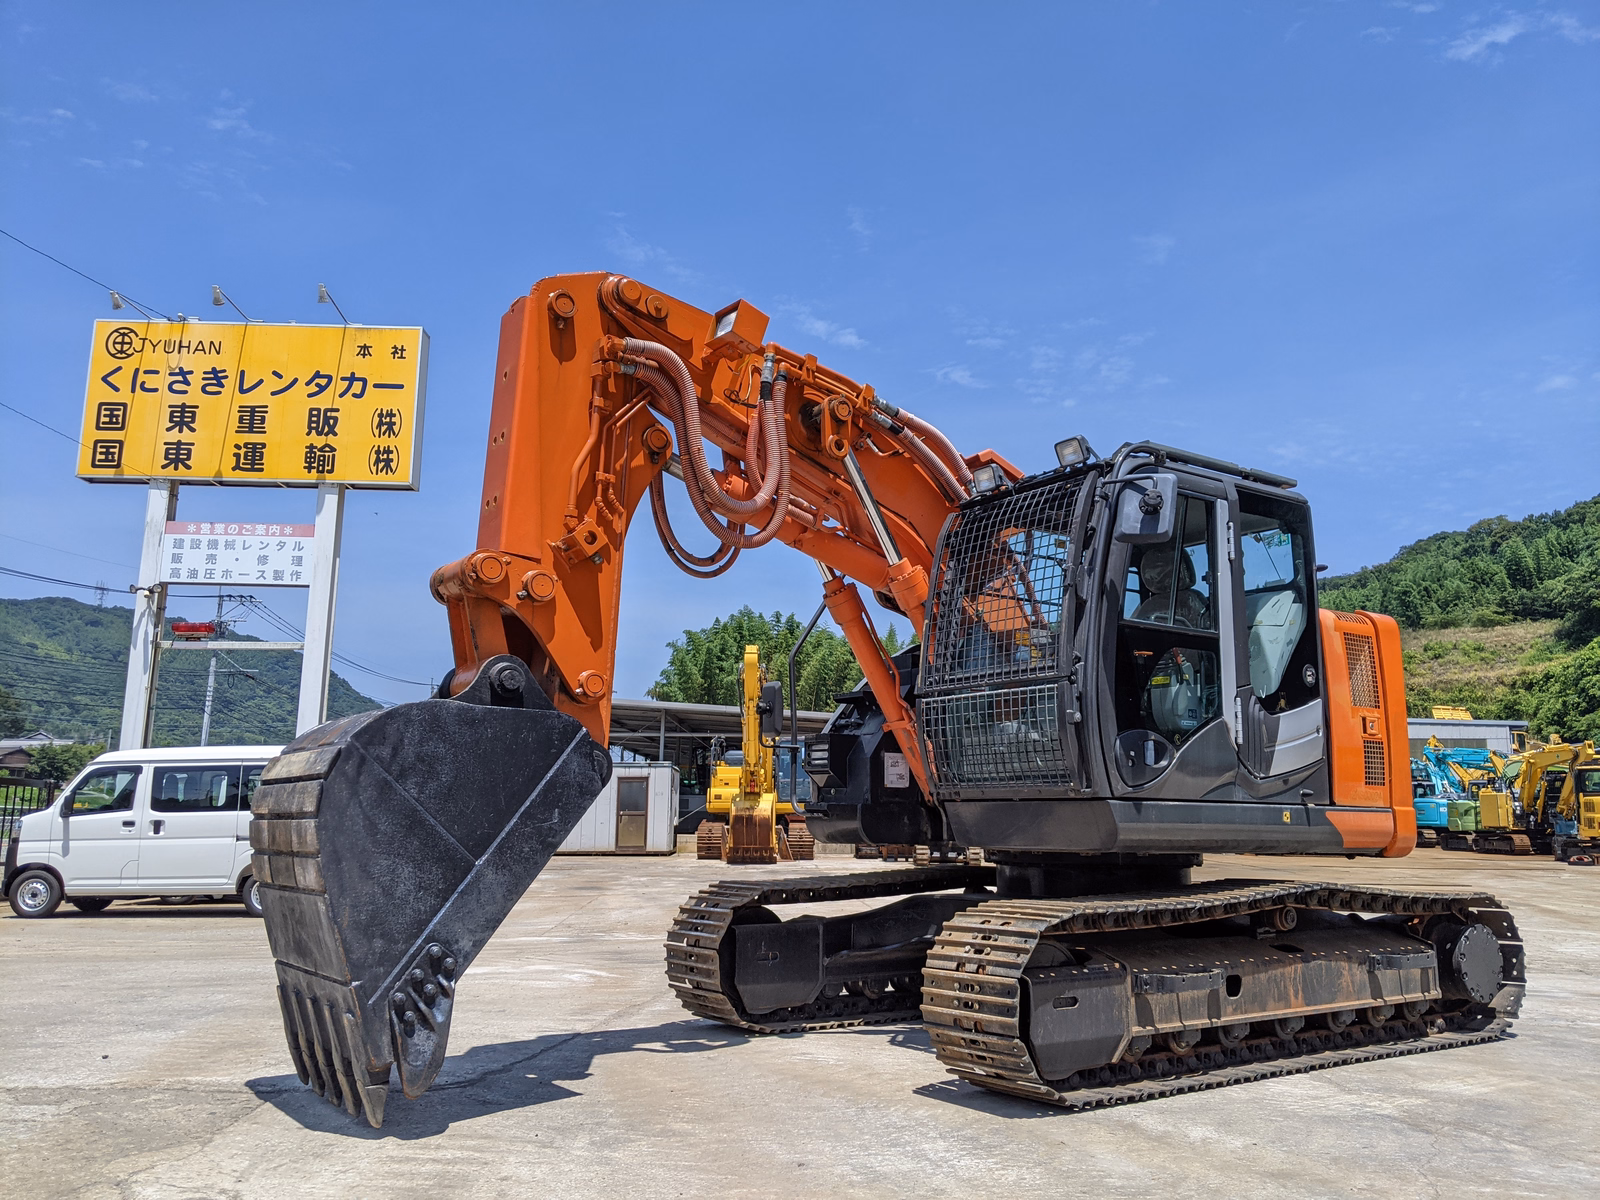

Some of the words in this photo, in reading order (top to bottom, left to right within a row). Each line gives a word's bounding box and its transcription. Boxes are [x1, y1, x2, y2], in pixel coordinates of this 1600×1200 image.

[356, 343, 407, 360] 本社
[100, 365, 405, 399] くにさきレンタカー
[172, 538, 305, 552] 建設機械レンタル
[169, 567, 302, 582] 高油圧ホース製作
